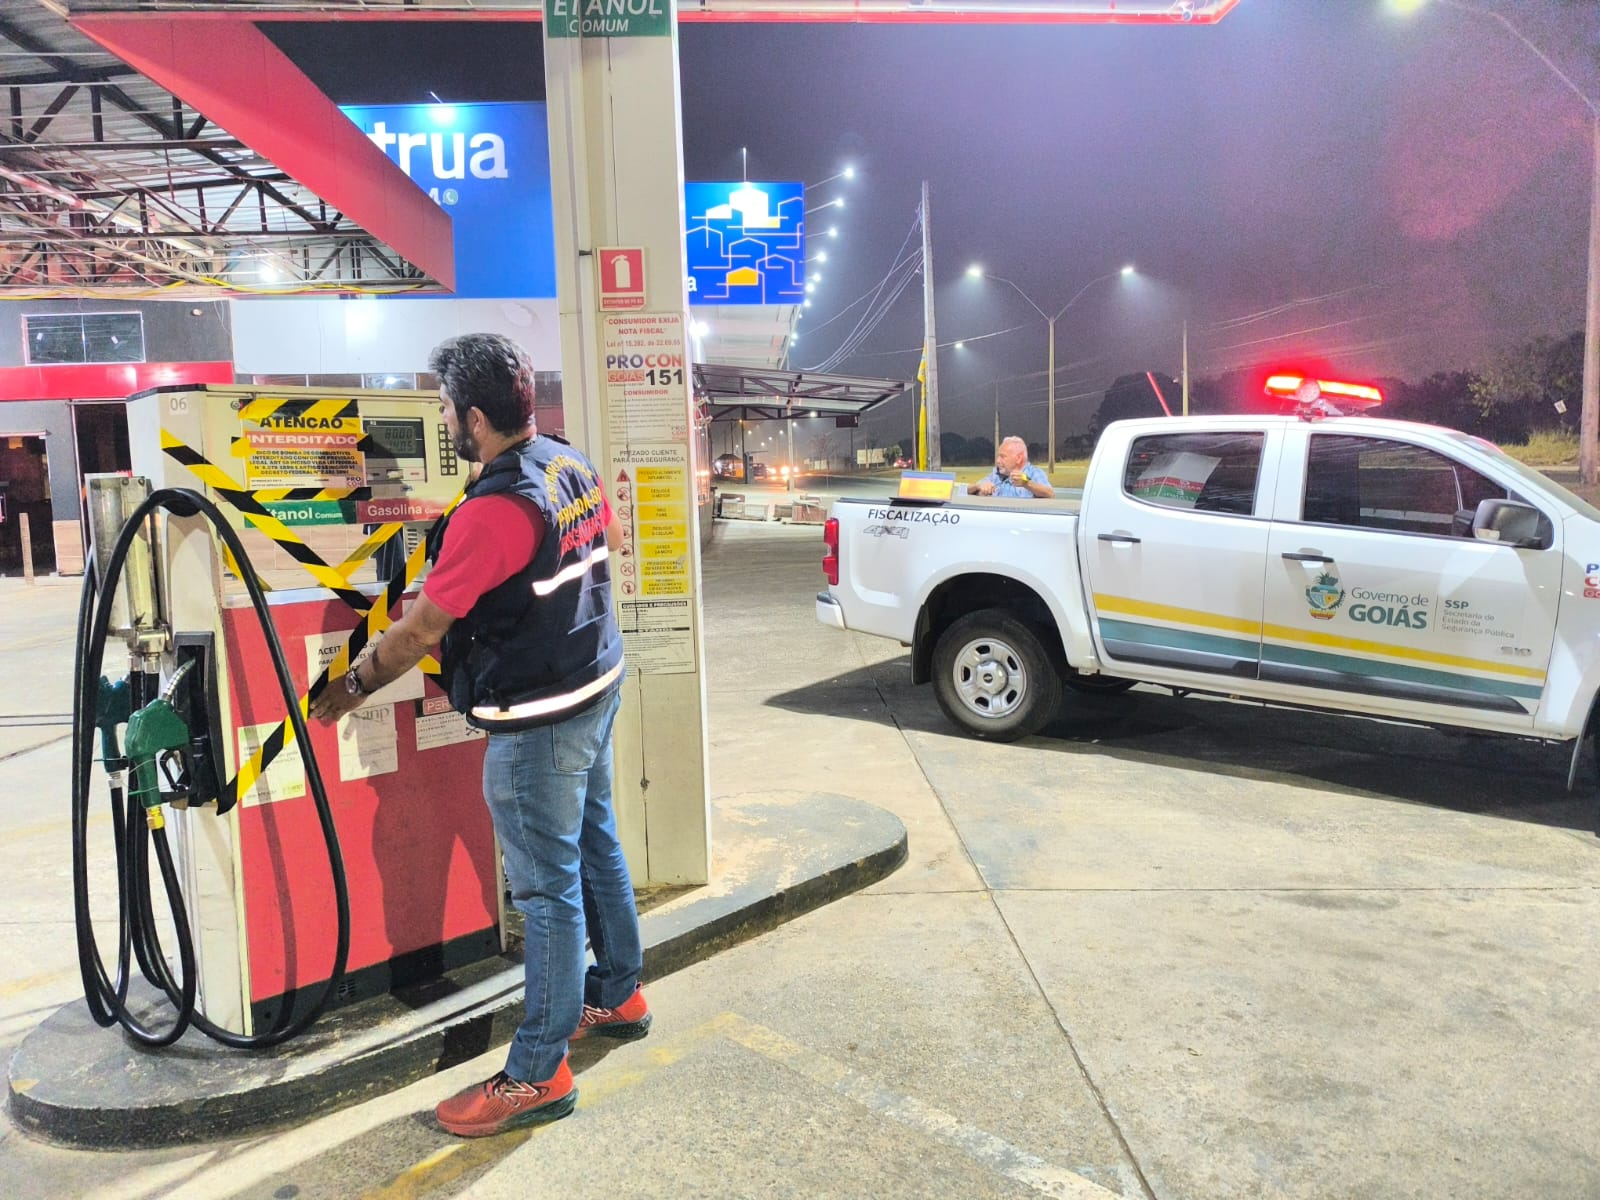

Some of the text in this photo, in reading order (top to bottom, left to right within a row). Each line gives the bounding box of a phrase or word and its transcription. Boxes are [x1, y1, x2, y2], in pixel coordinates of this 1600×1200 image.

[569, 19, 629, 32] COMUM
[606, 354, 683, 369] PROCON
[646, 369, 683, 386] 151
[170, 397, 188, 411] 06
[246, 434, 357, 445] INTERDITADO
[266, 507, 312, 520] tanol
[367, 504, 422, 516] Gasolina
[868, 509, 960, 526] FISCALIZAÇÃO
[1351, 587, 1429, 606] Governo de
[1445, 600, 1469, 610] SSP
[1348, 604, 1427, 629] GOIÁS
[1443, 609, 1483, 620] Secretaria
[1441, 624, 1515, 639] Segurança Pública
